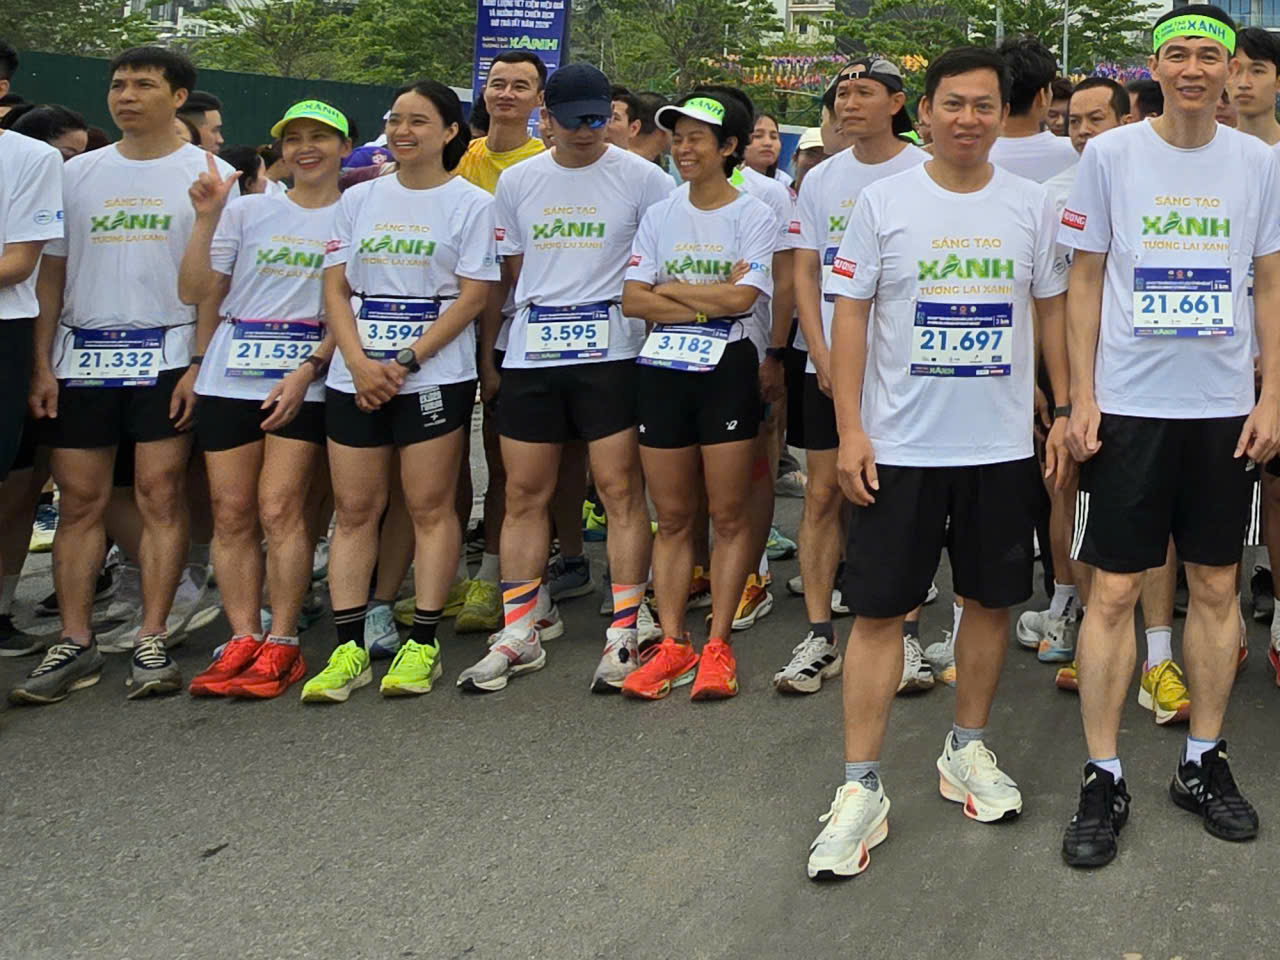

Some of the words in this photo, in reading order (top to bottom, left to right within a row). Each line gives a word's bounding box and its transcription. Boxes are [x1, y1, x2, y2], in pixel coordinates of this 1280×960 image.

[1187, 19, 1226, 40] XANH
[1155, 195, 1191, 207] SÁNG
[1195, 197, 1220, 209] TẠO
[91, 210, 172, 232] XANH
[533, 218, 606, 240] XANH
[1142, 210, 1230, 237] XANH
[359, 234, 437, 256] XANH
[932, 237, 970, 249] SÁNG
[974, 238, 1002, 250] TẠO
[664, 255, 732, 276] XANH
[918, 253, 1014, 281] XANH
[1141, 294, 1220, 314] 21.661
[367, 323, 425, 341] 3.594
[541, 324, 597, 341] 3.595
[920, 330, 1003, 351] 21.697
[236, 342, 314, 359] 21.532
[658, 335, 713, 355] 3.182
[79, 351, 154, 368] 21.332
